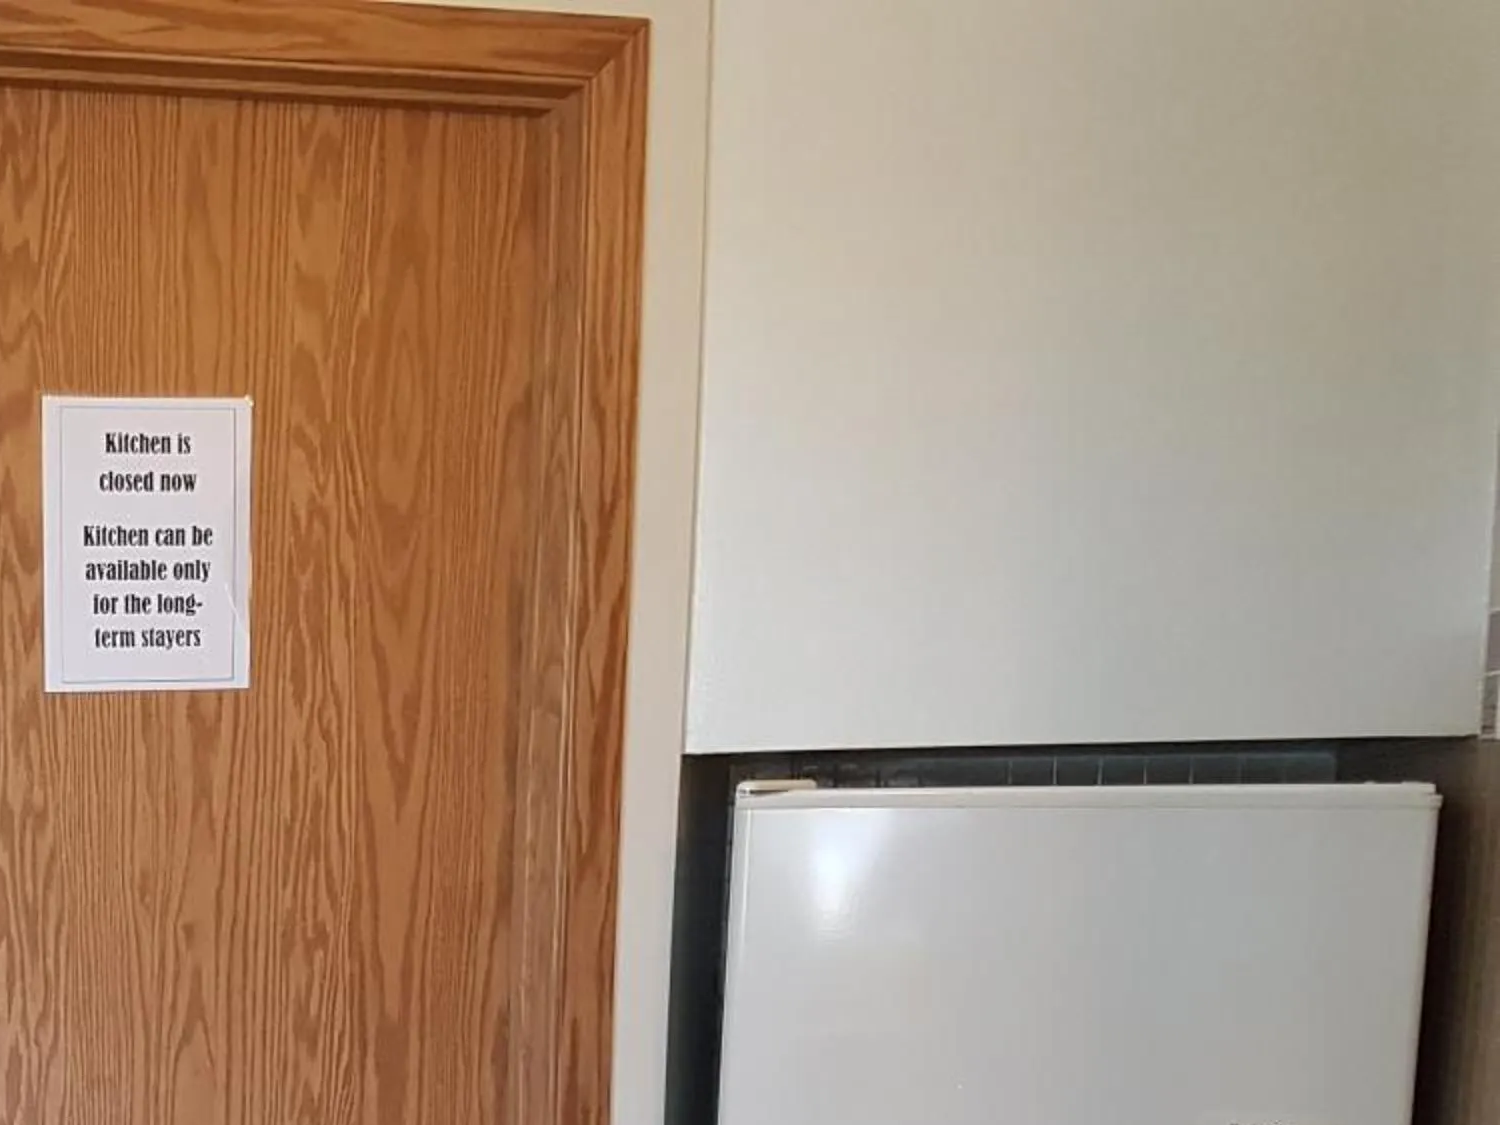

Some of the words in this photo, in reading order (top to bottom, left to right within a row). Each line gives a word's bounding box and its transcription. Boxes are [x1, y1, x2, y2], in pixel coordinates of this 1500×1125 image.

[105, 432, 171, 454] Kitchen
[177, 433, 191, 454] is
[100, 471, 154, 492] closed
[160, 474, 197, 492] now
[83, 526, 149, 547] Kitchen
[155, 528, 185, 546] can
[191, 526, 213, 546] be
[85, 560, 167, 581] available
[173, 560, 211, 582] only
[93, 594, 118, 614] for
[124, 594, 151, 614] the
[157, 594, 203, 615] long-
[95, 629, 135, 648] term
[141, 629, 201, 650] stayers
